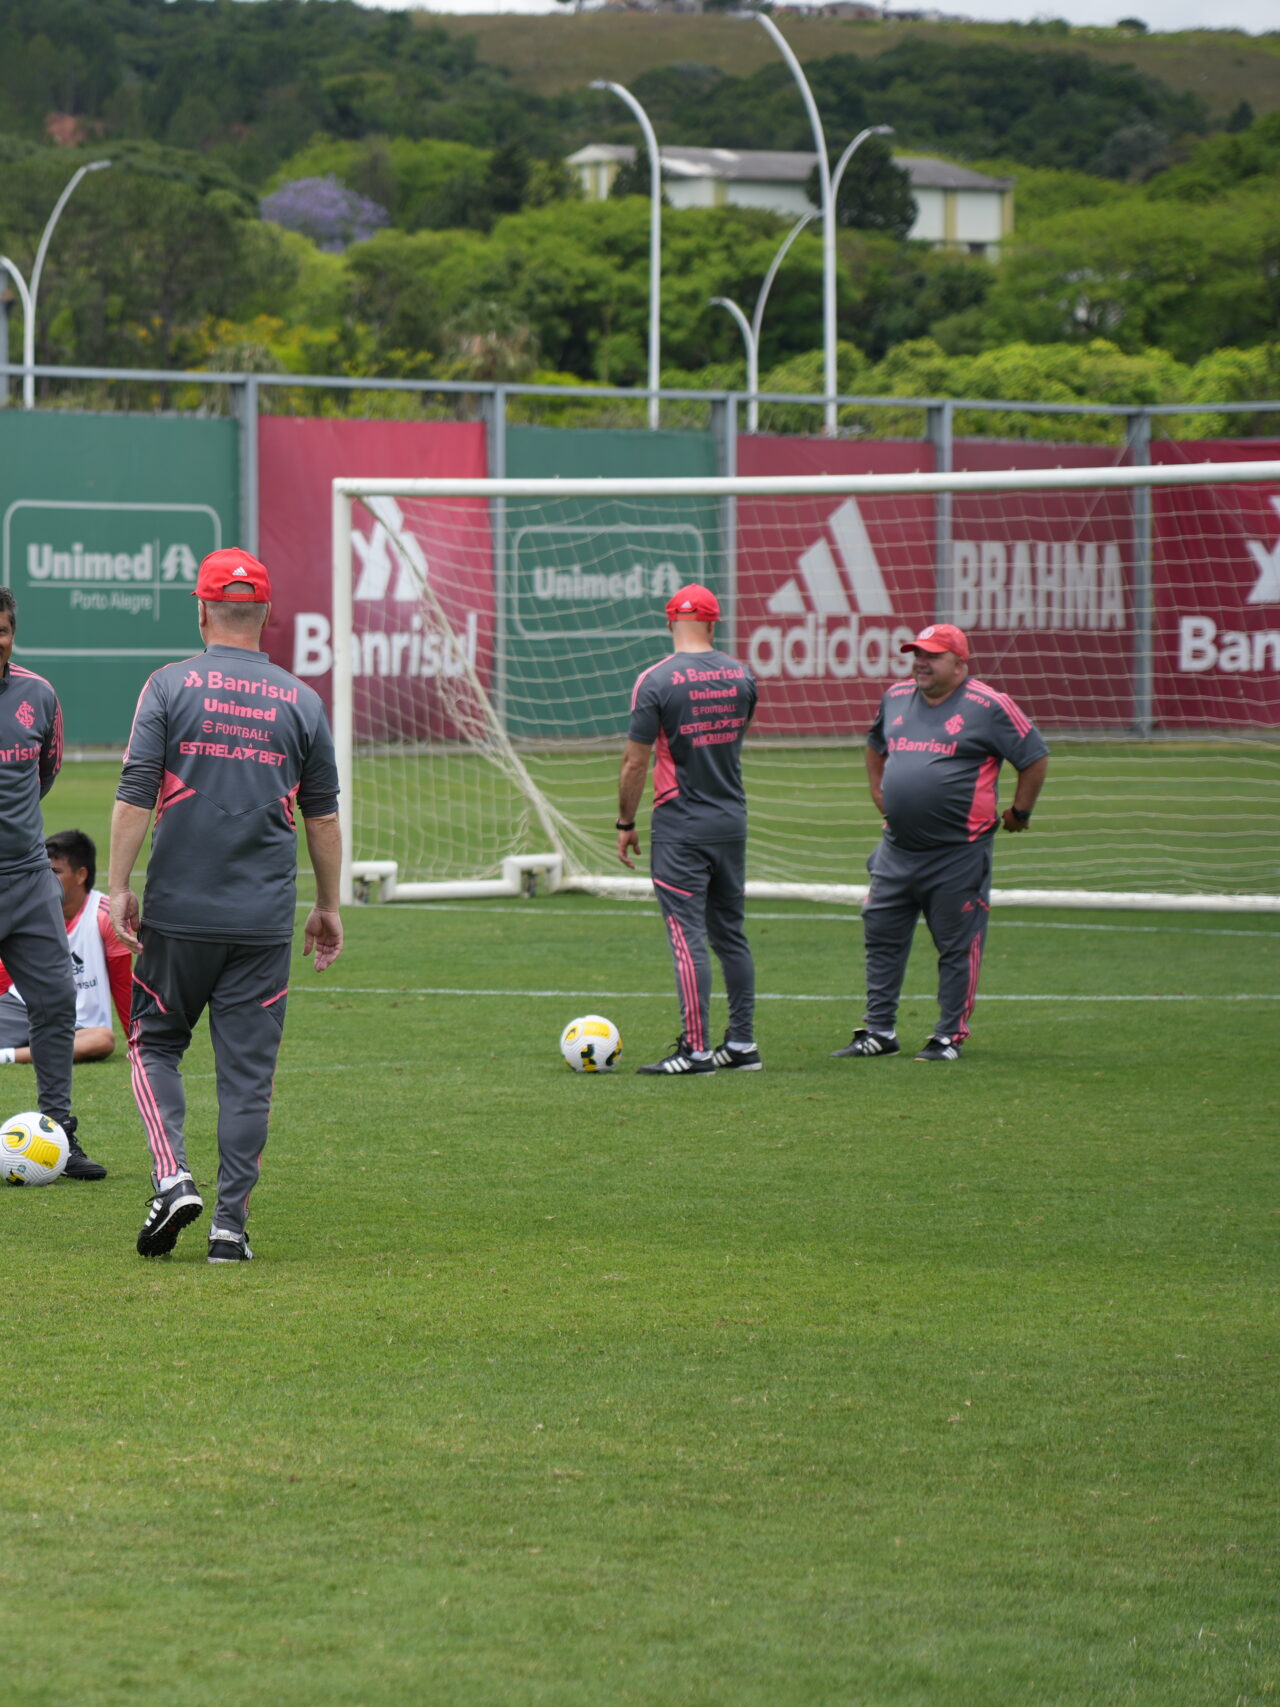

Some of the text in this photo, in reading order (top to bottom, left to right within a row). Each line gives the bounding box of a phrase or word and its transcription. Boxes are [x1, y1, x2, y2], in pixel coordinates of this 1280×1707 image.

[27, 542, 153, 581] Unimed
[534, 564, 643, 600] Unimed
[953, 540, 1126, 630] BRAHMA
[71, 590, 107, 609] Porto
[749, 611, 914, 679] adidas
[207, 671, 298, 704] Banrisul
[686, 666, 745, 682] Banrisul
[689, 685, 738, 700] Unimed
[204, 698, 277, 722] Unimed
[896, 737, 959, 756] Banrisul
